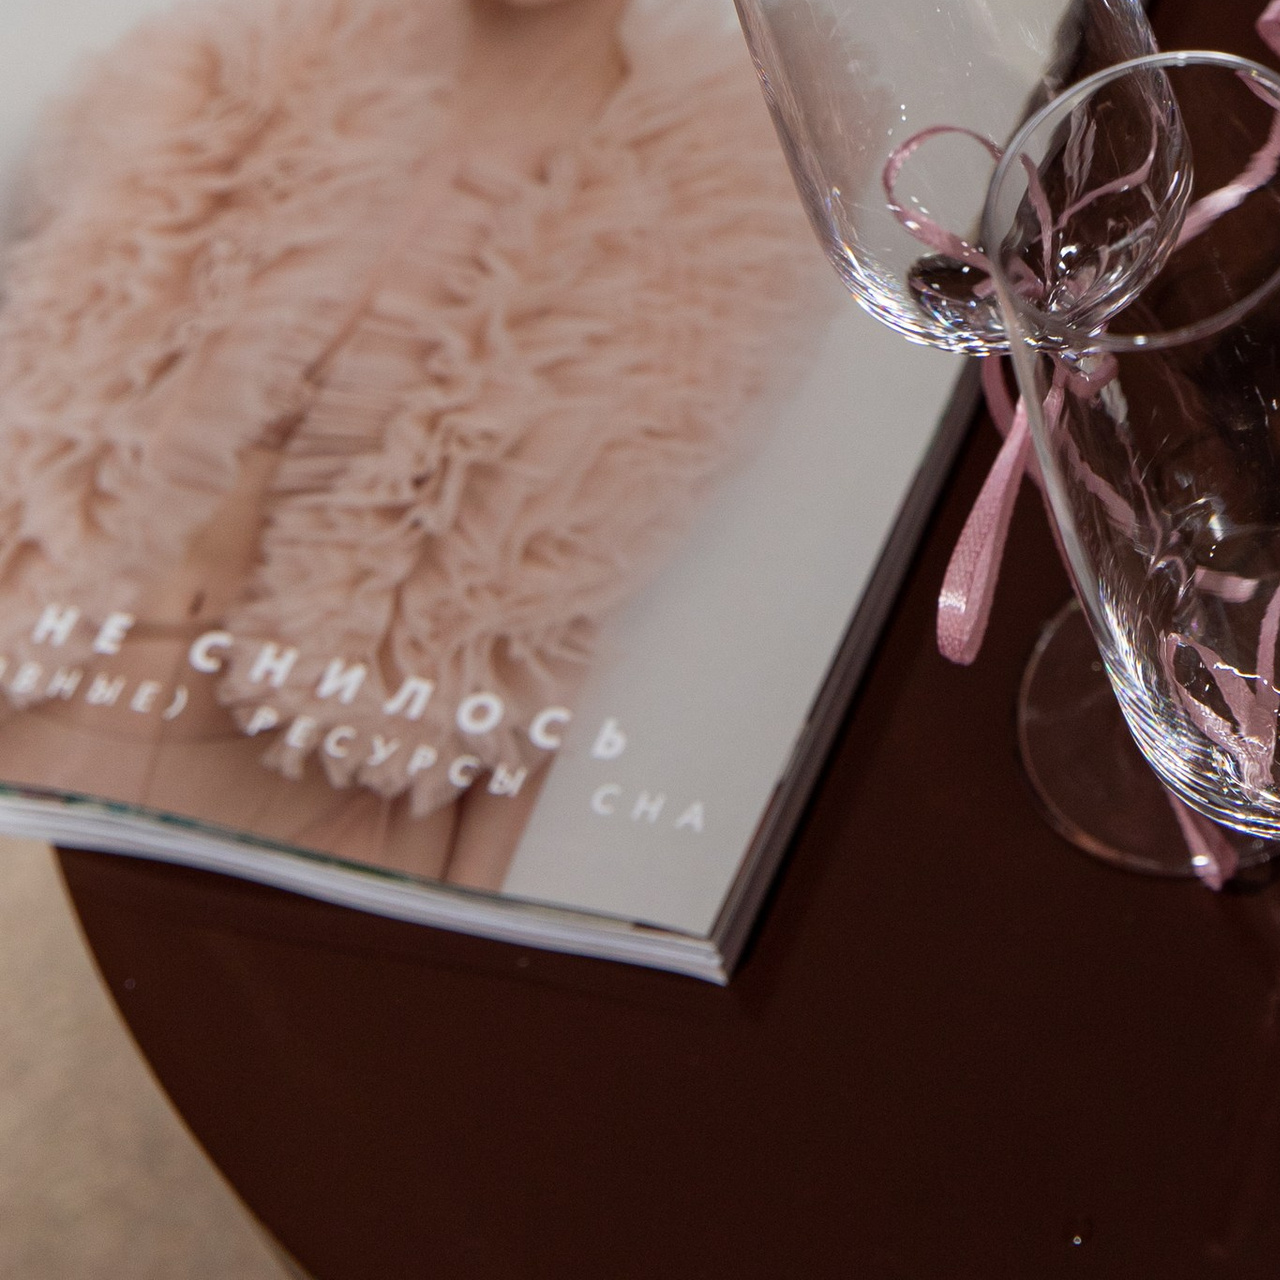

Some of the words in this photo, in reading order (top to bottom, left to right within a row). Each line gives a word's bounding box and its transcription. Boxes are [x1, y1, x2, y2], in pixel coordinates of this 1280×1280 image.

[32, 603, 136, 656] НЕ
[188, 630, 628, 761] СНИЛОСЬ
[244, 704, 528, 798] РЕСУРСЫ
[590, 783, 706, 834] СНА
